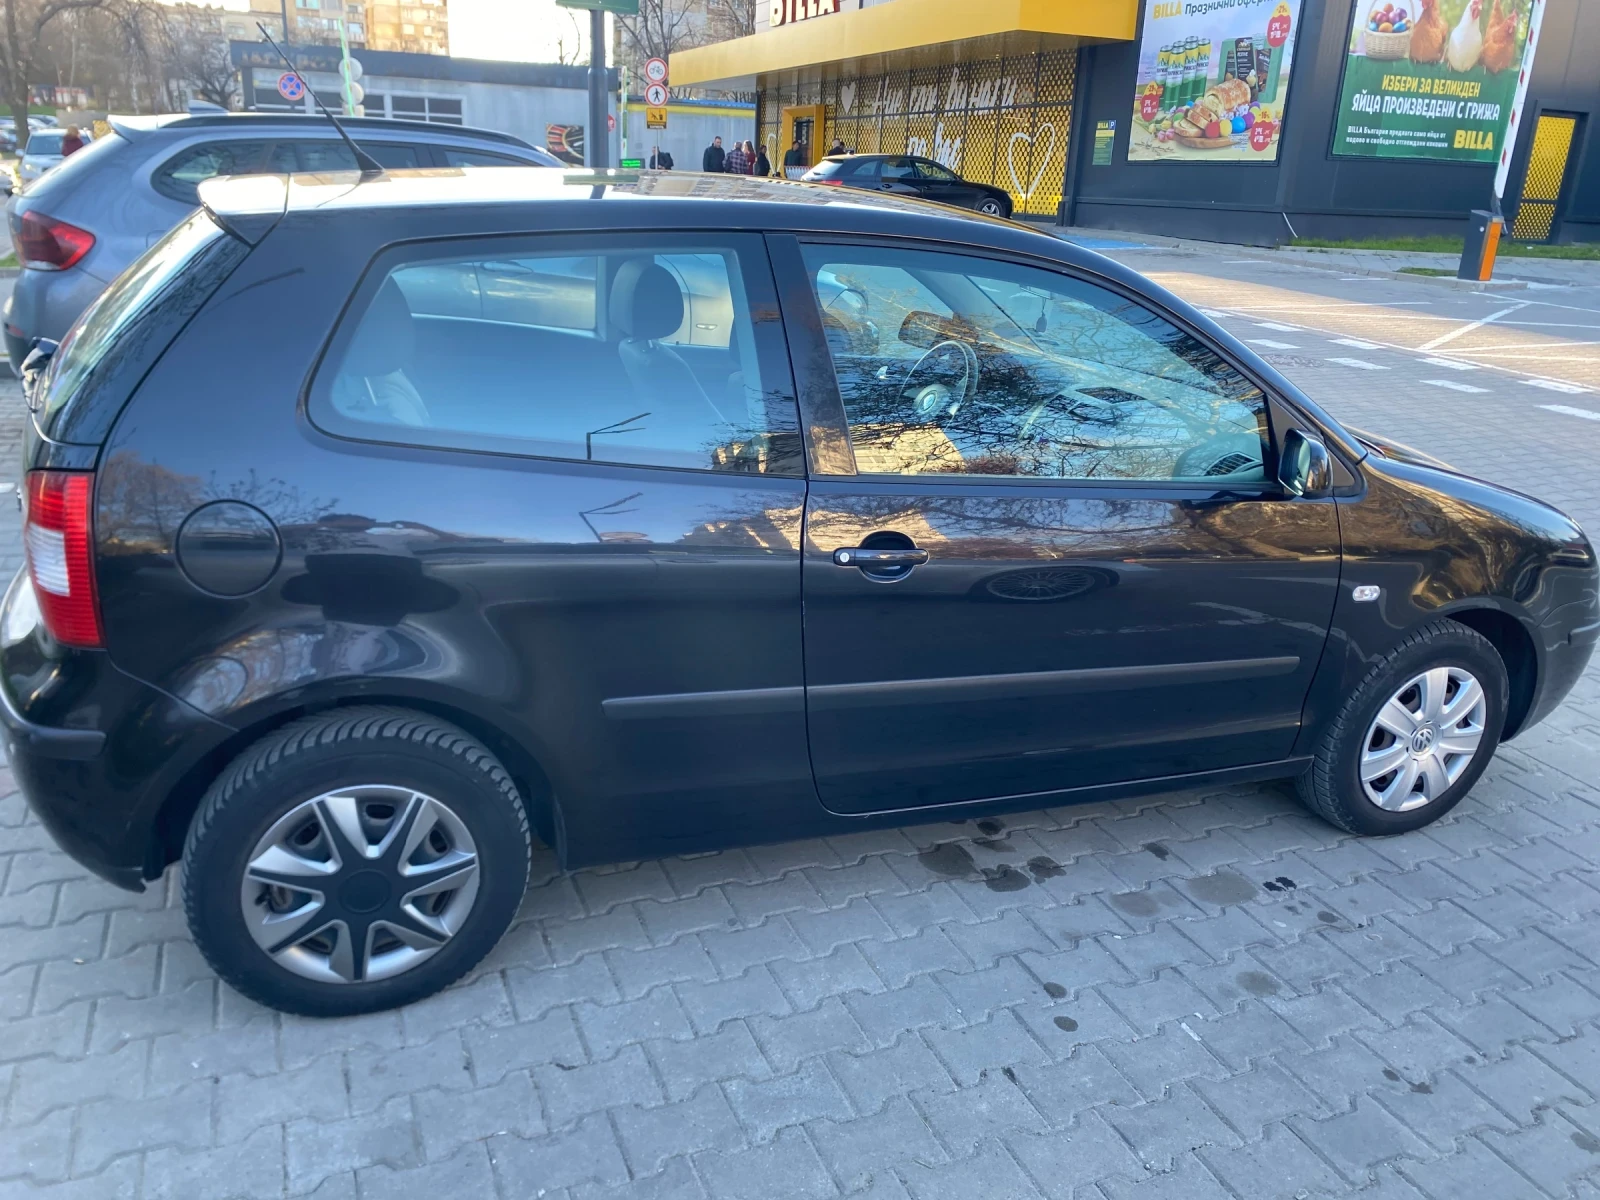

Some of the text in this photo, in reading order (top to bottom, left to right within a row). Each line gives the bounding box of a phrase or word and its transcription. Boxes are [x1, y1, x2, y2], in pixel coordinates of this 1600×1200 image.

[1153, 1, 1182, 19] BILLA
[1185, 0, 1273, 16] Празнични офер
[1381, 74, 1482, 98] ИЗБЕРИ ЗА ВЕЛИКДЕН
[1351, 89, 1501, 121] ЯЙЦА ПРОИЗВЕДЕНИ С ГРИЖА
[1347, 125, 1363, 133] BILLA
[1363, 126, 1389, 136] България
[1389, 129, 1413, 137] предлага
[1427, 130, 1440, 138] яйца
[1453, 129, 1494, 150] BILLA
[1370, 137, 1396, 145] свободно
